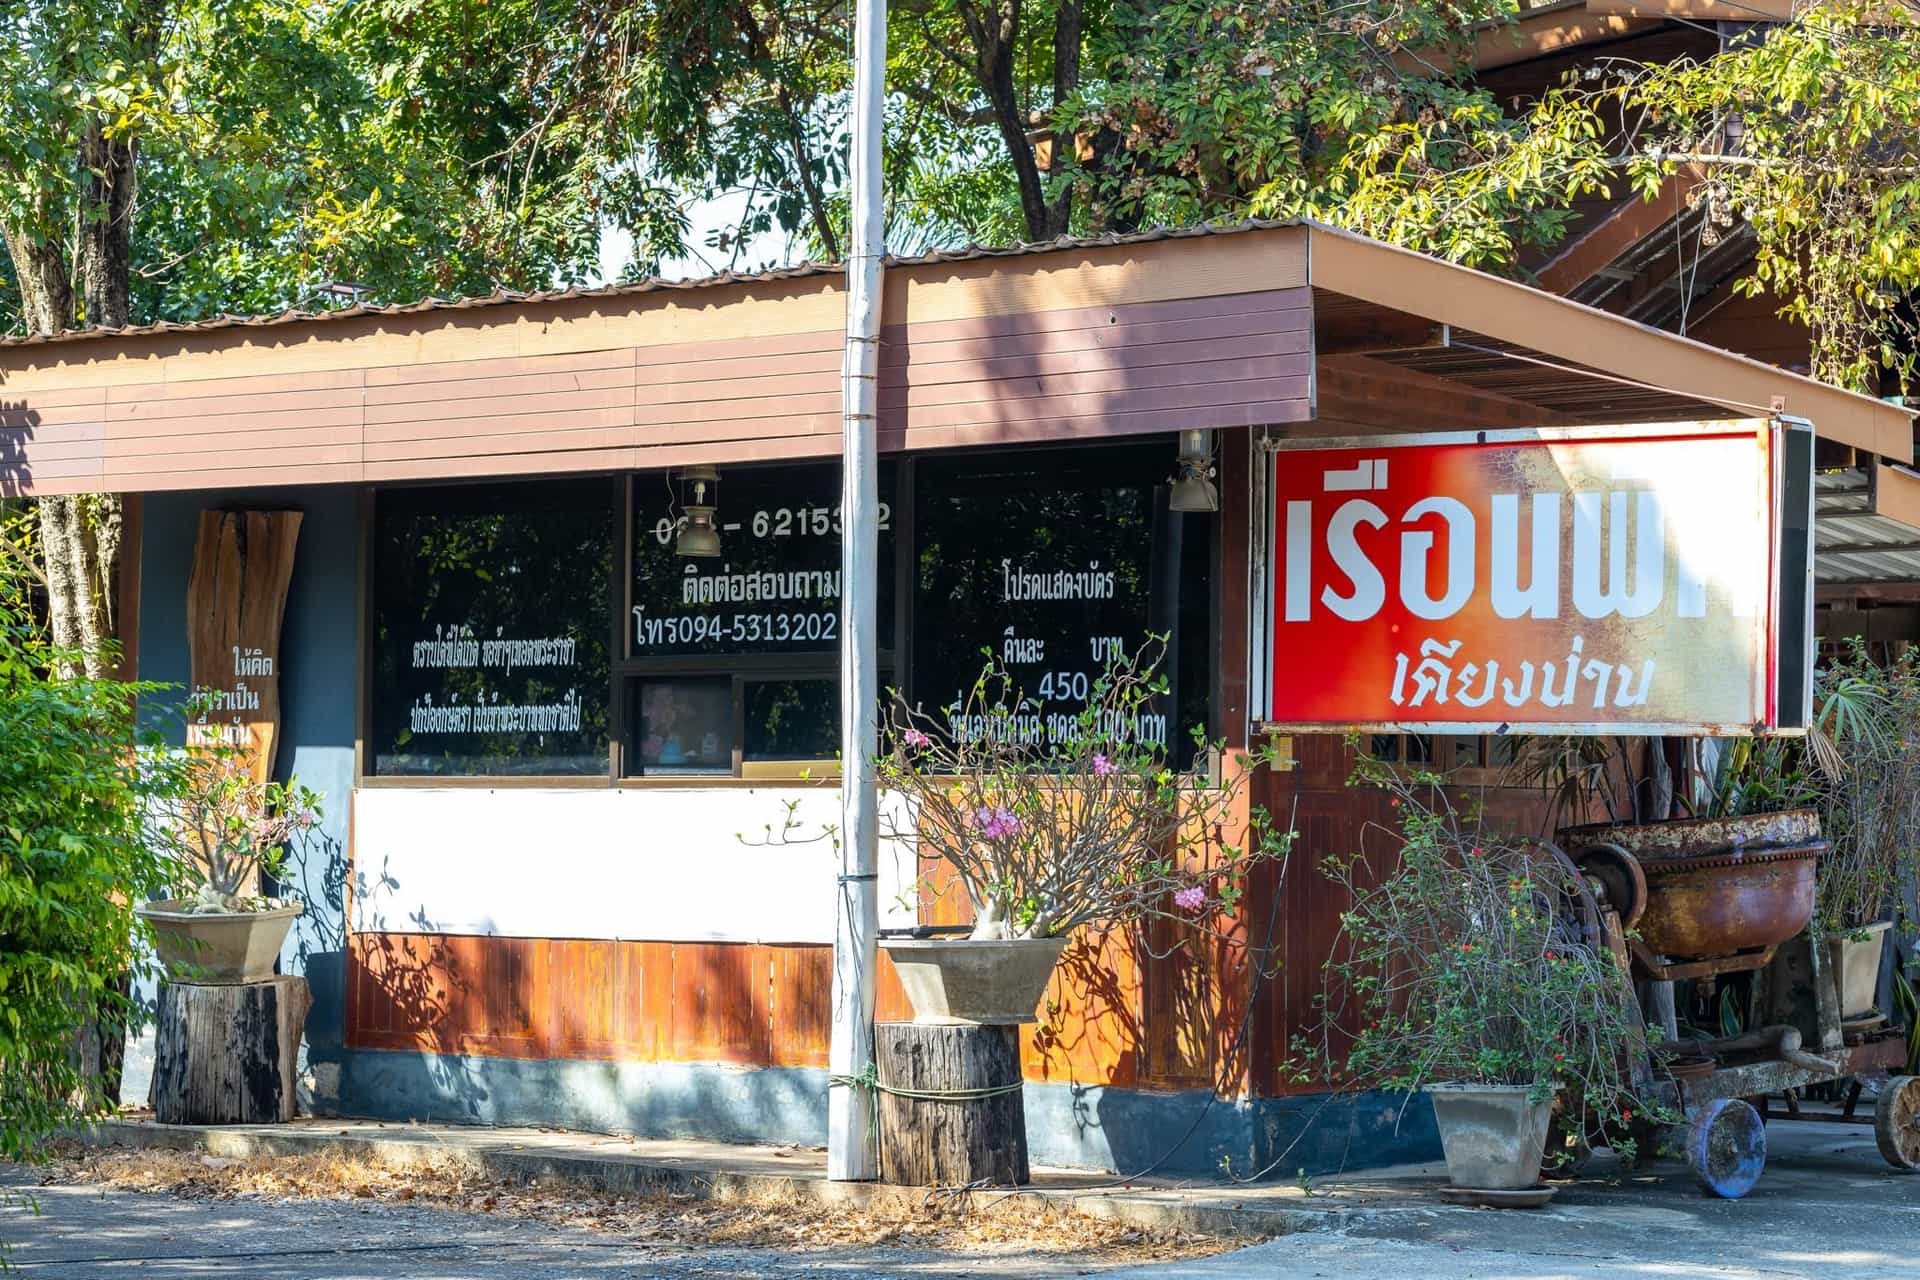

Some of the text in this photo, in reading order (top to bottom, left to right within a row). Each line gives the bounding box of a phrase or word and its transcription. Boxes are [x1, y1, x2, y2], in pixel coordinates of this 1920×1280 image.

[752, 502, 891, 538] 621532
[1285, 459, 1756, 622] เรือนพ
[682, 563, 842, 605] ติดต่อสอบถาม
[1001, 558, 1116, 602] โปรดแสดงบัตร
[631, 604, 838, 646] โทร094-5313202
[1003, 625, 1124, 664] คืนละ บาท
[232, 645, 273, 677] ให้คิด
[1390, 635, 1657, 709] เคียงน่าน
[1038, 671, 1088, 701] 450
